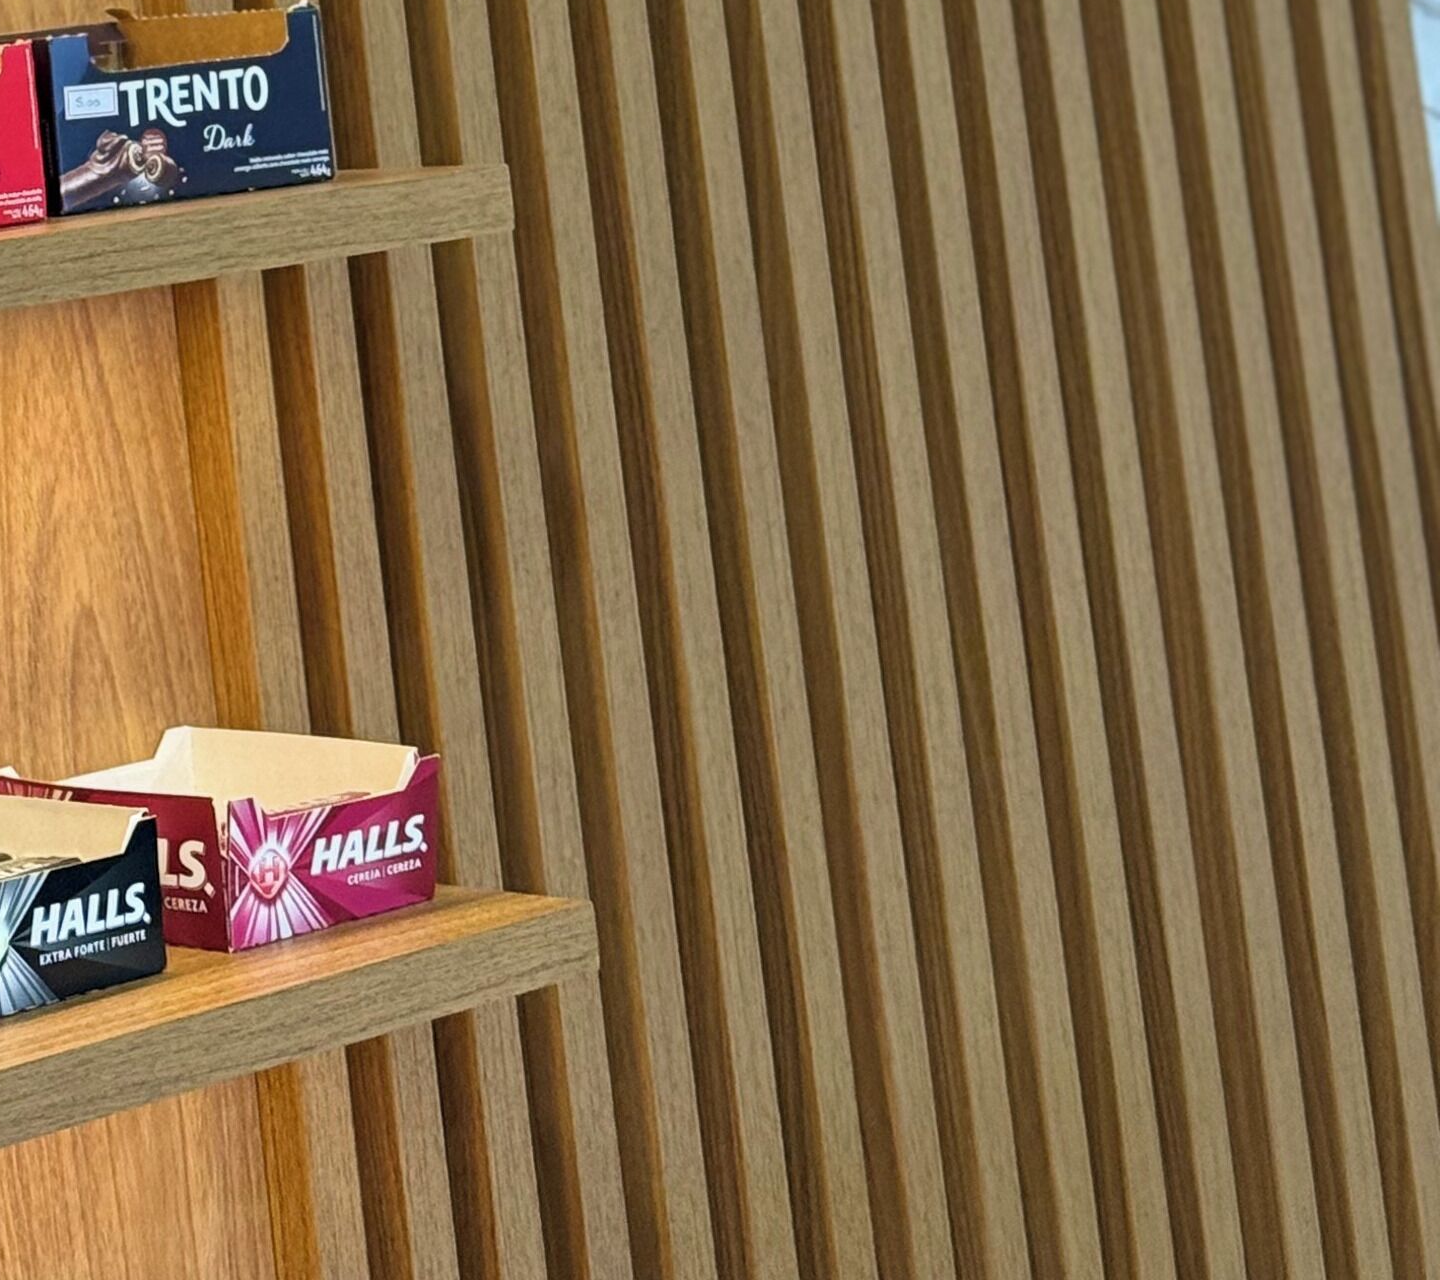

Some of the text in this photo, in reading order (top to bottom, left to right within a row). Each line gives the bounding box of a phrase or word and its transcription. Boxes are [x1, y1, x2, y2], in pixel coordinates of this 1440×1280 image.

[119, 65, 268, 127] TRENTO
[203, 123, 256, 152] Dark
[347, 858, 422, 886] CEREJA CEREZA
[163, 896, 208, 914] CEREZA
[39, 929, 147, 967] EXTRA FORTE FUERTE
